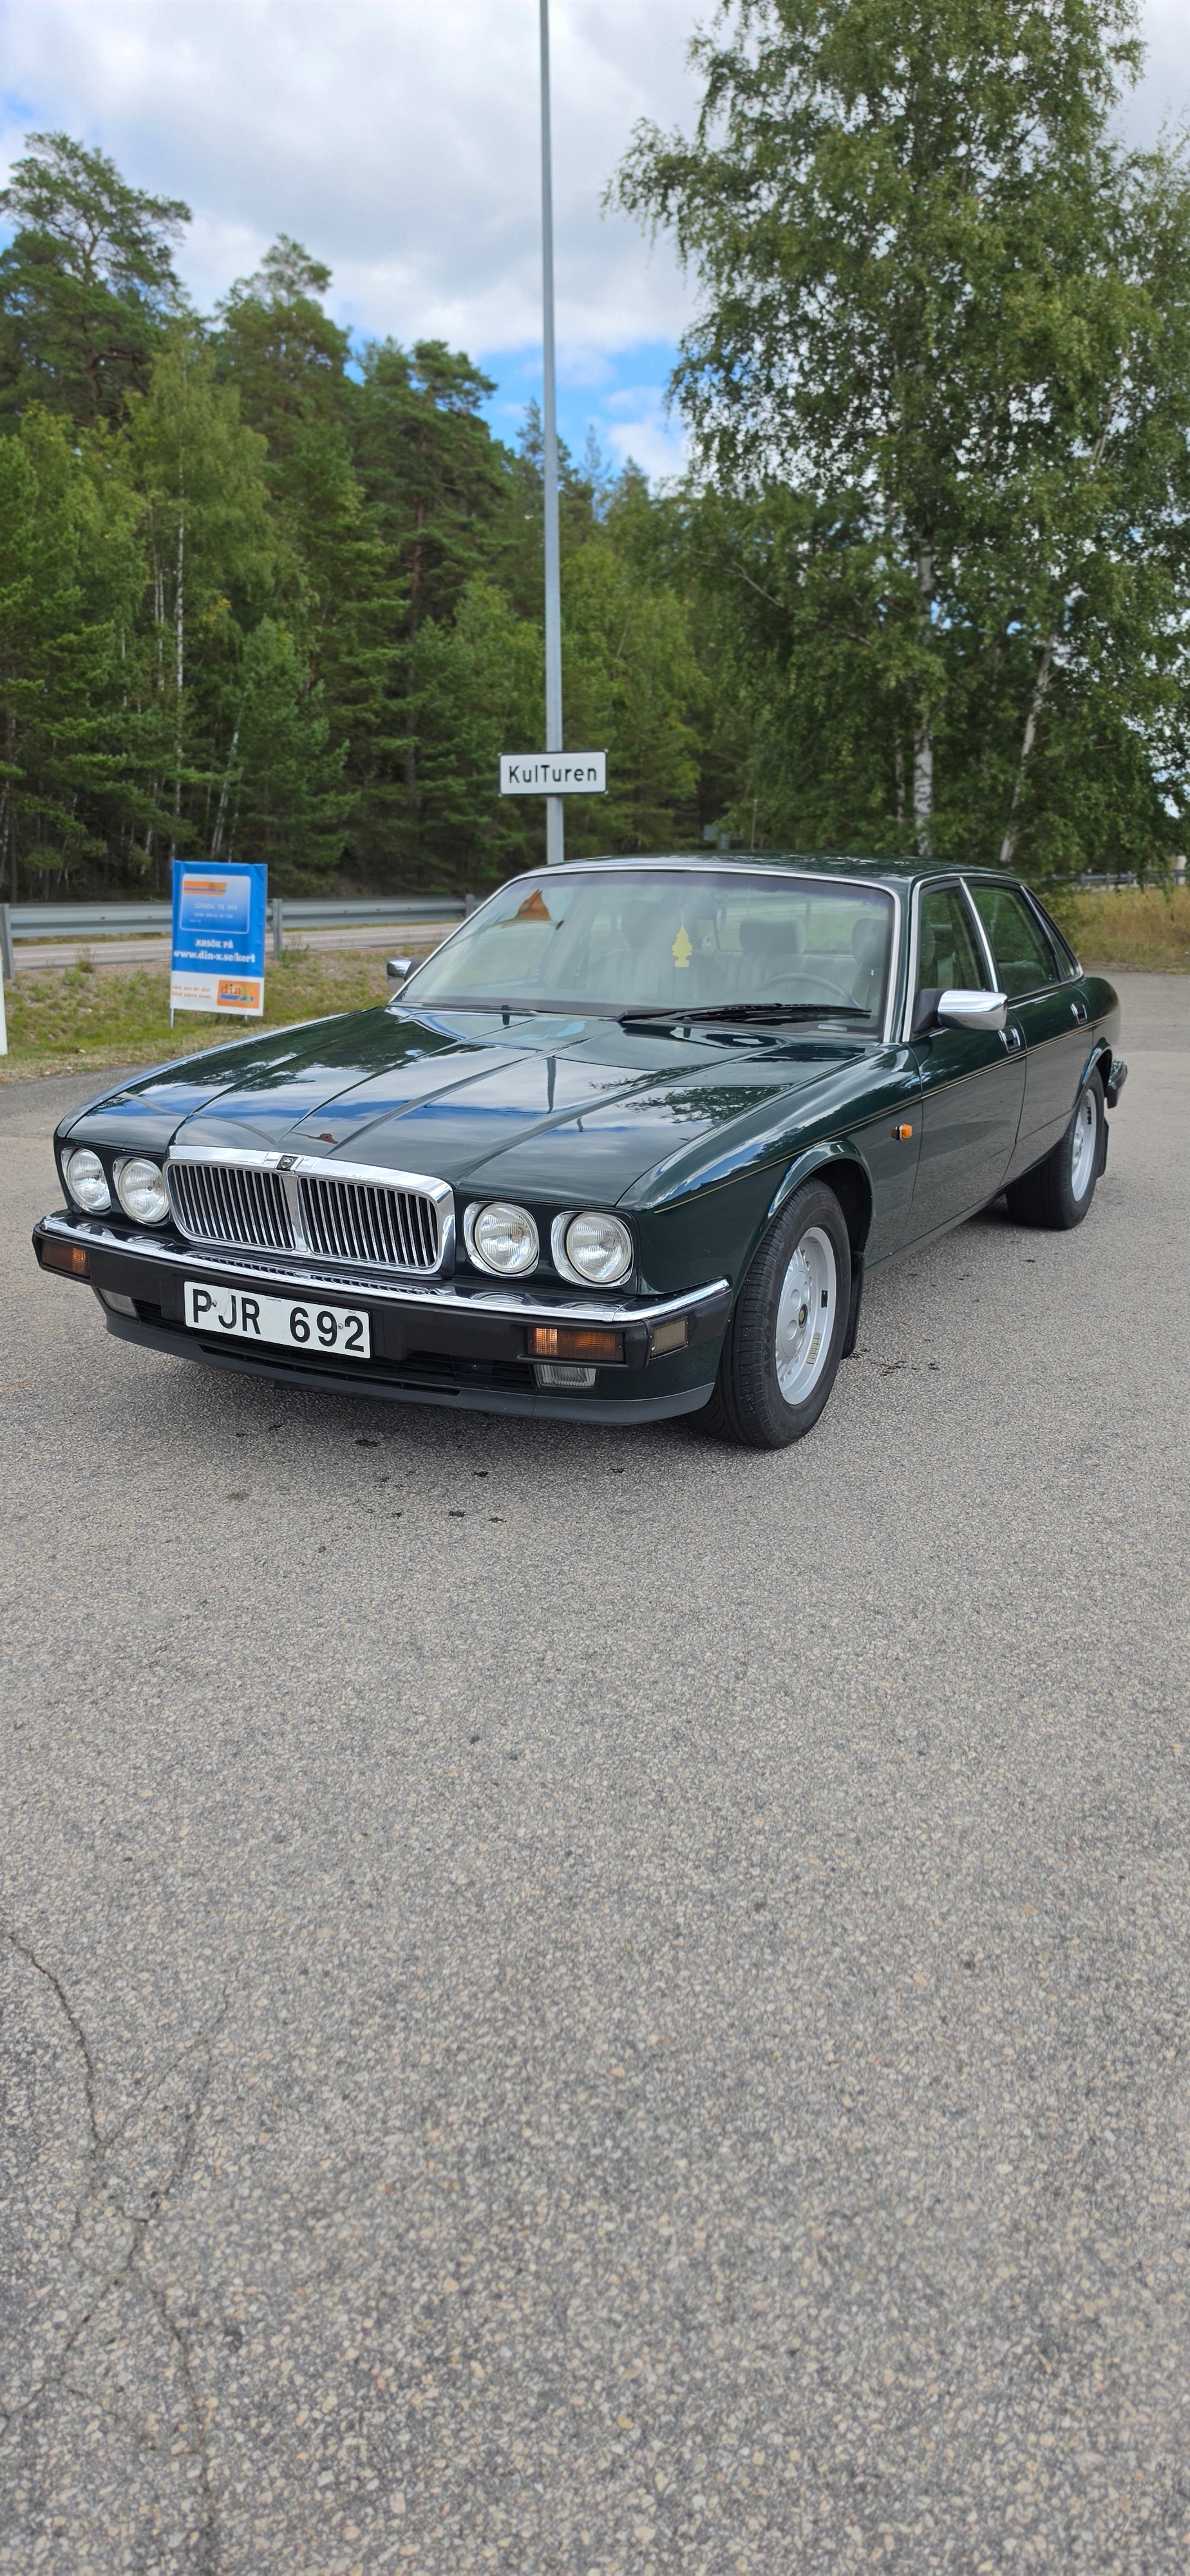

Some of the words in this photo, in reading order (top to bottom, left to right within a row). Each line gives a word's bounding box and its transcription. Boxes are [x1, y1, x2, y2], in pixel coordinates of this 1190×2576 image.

[509, 764, 597, 784] KulTuren
[195, 939, 222, 949] ANSÖK
[223, 939, 234, 949] PÅ
[193, 1288, 261, 1335] PJR
[289, 1307, 364, 1352] 692
